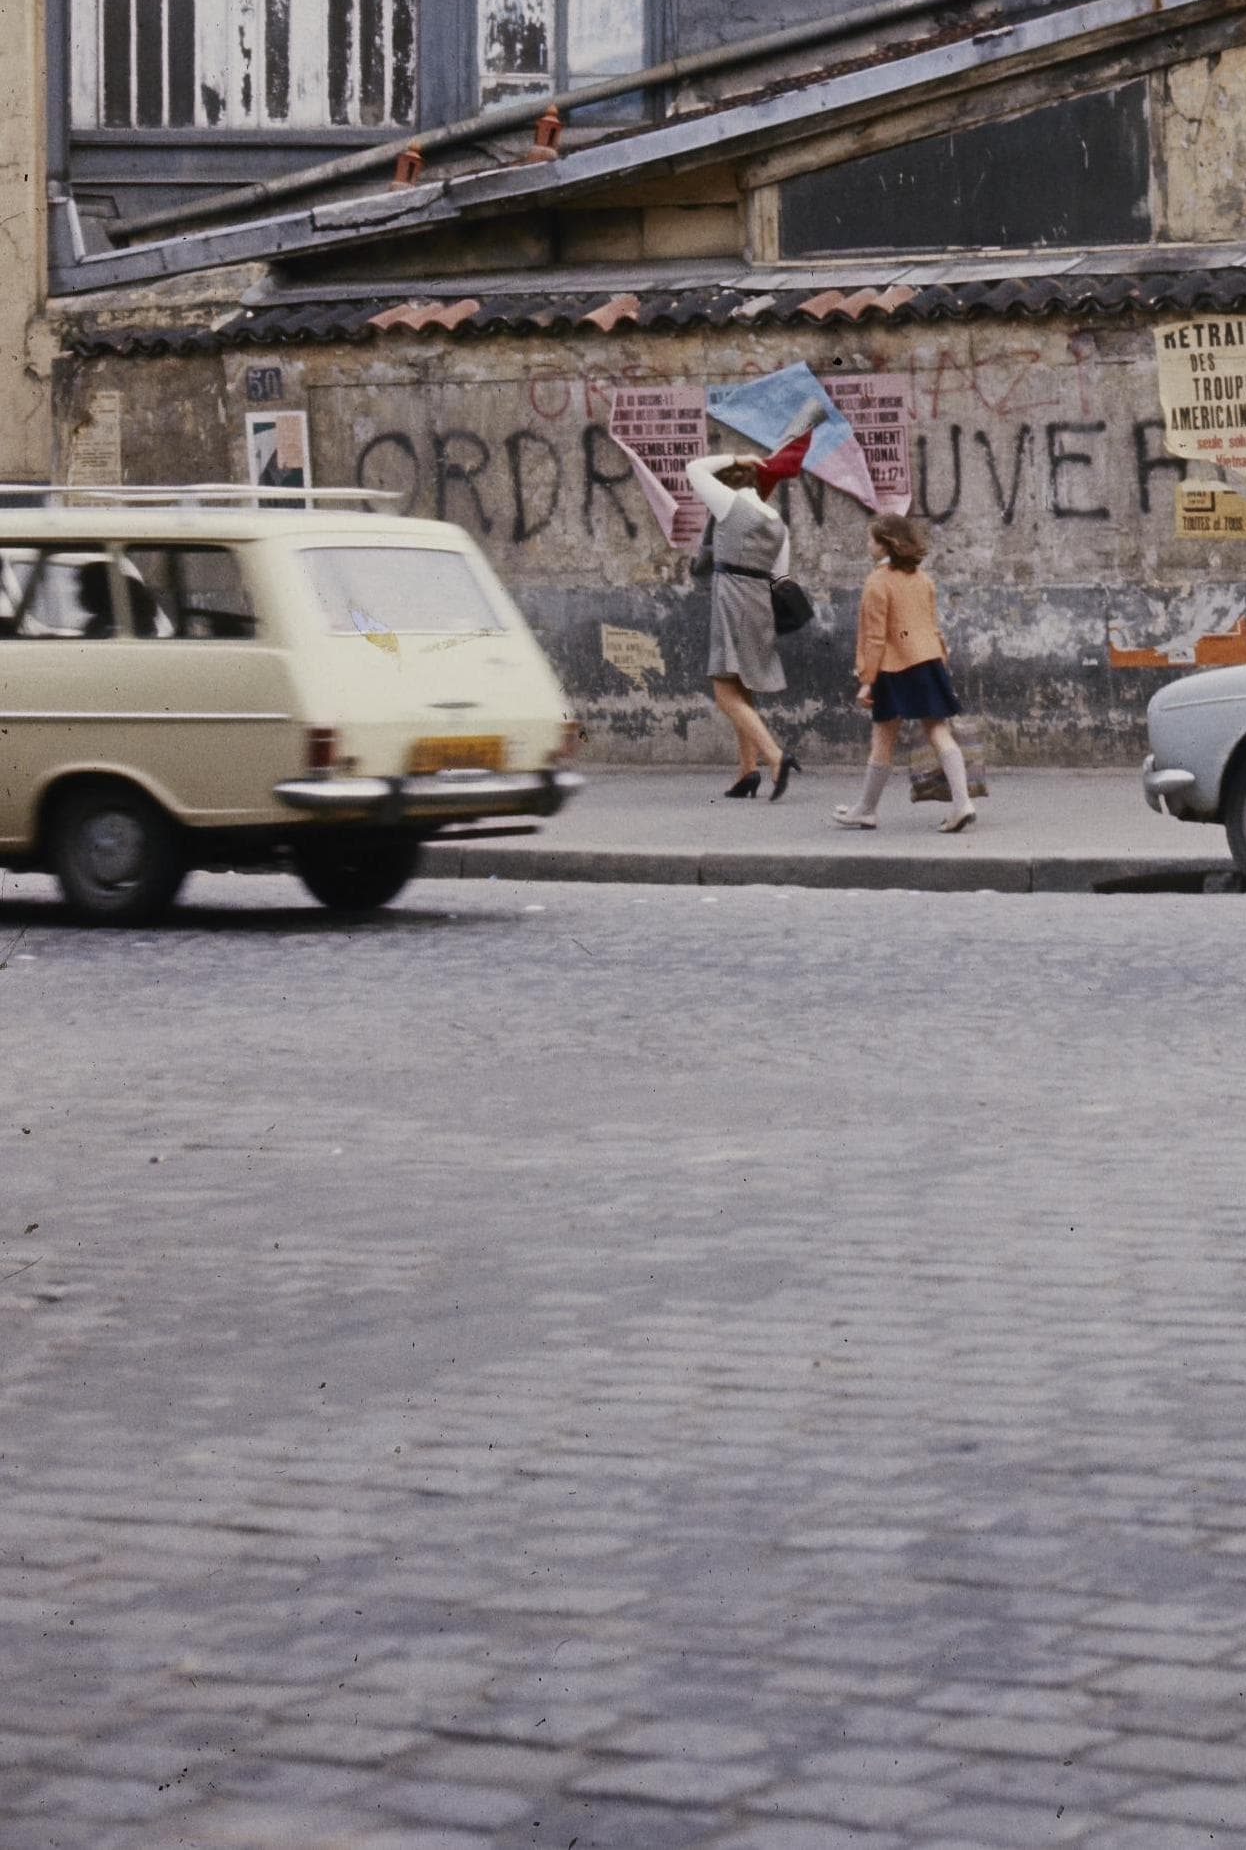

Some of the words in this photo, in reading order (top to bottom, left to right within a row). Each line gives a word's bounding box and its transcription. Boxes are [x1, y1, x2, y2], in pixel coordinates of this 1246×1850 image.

[1190, 353, 1215, 372] DES
[1197, 435, 1223, 449] seule
[356, 423, 640, 544] ORDR
